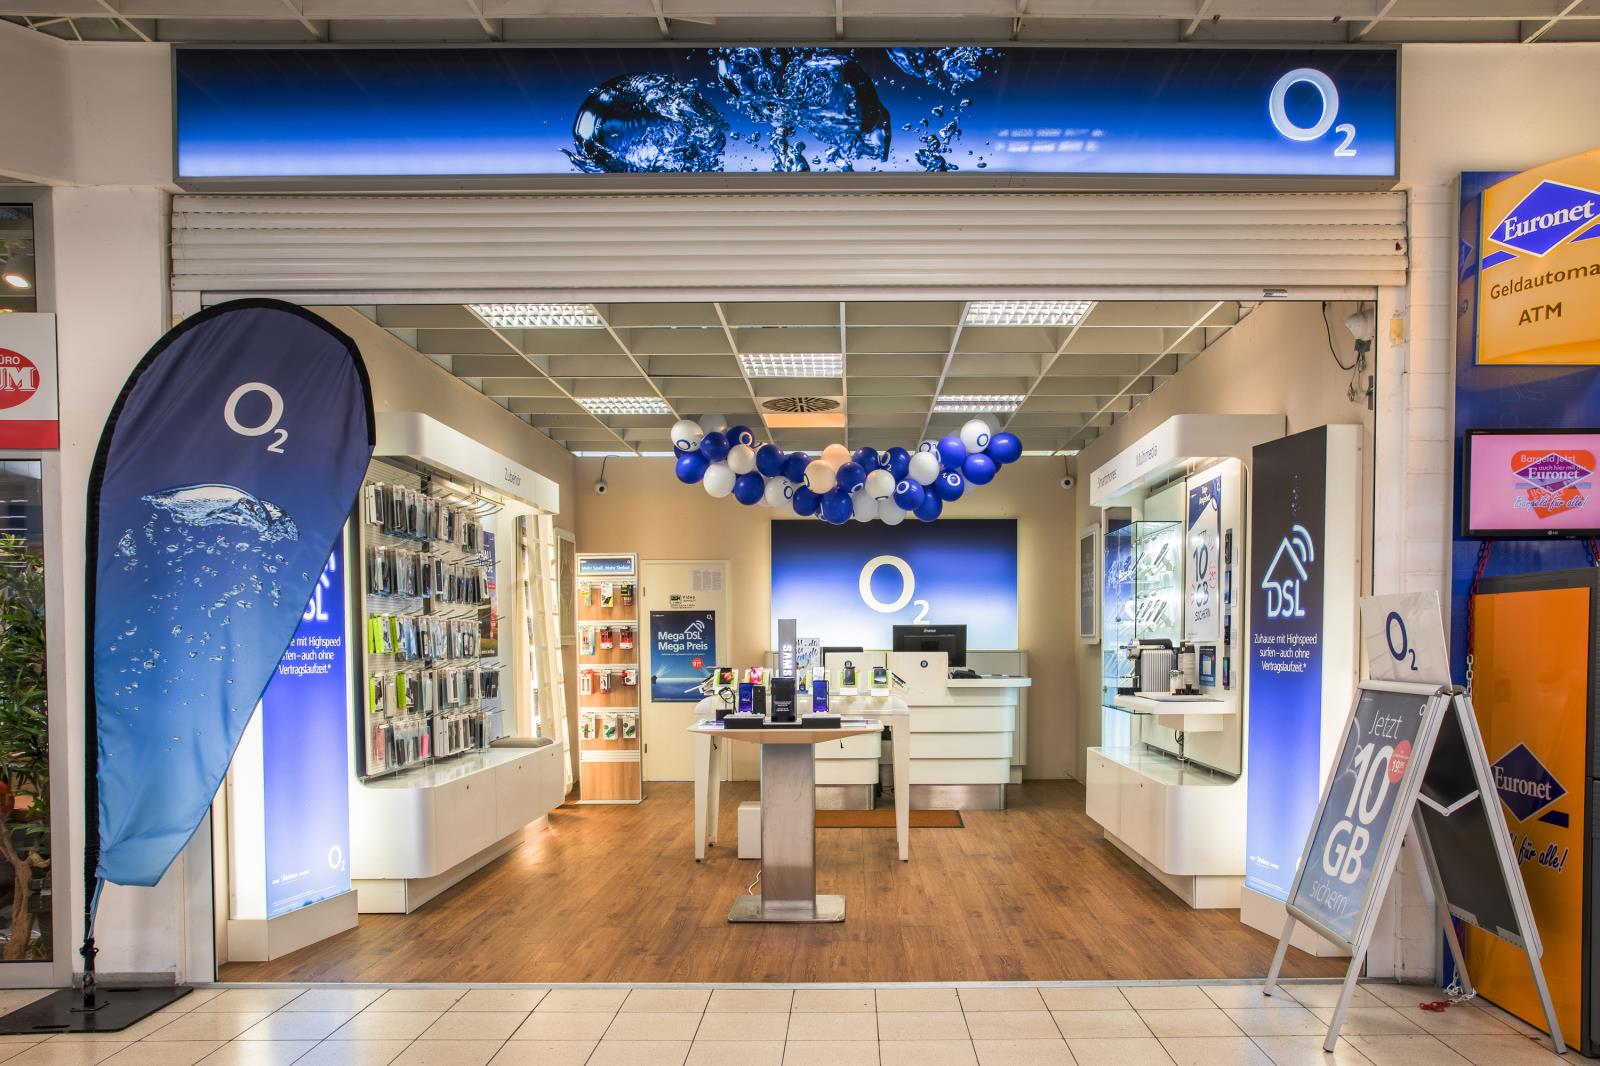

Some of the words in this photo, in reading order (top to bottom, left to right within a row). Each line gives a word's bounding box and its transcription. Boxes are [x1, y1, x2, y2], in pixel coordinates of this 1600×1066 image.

[1268, 67, 1358, 157] O2
[1502, 199, 1595, 243] Euronet
[1518, 301, 1563, 326] ATM
[224, 382, 289, 454] O2
[1528, 467, 1580, 480] Euronet
[859, 554, 930, 627] O2
[1267, 580, 1306, 617] DSL
[296, 636, 308, 647] mit
[308, 636, 341, 649] Highspeed
[658, 631, 685, 642] Mega
[686, 631, 702, 640] DSL
[658, 641, 685, 652] Mega
[686, 641, 708, 651] Preis
[1254, 633, 1276, 644] Zuhause
[1276, 633, 1286, 644] mit
[1286, 633, 1318, 647] Highspeed
[1385, 611, 1418, 671] O2
[318, 650, 335, 660] ohne
[1294, 648, 1310, 659] ohne
[1367, 709, 1404, 740] Jetzt
[1343, 742, 1395, 825] 10
[1494, 764, 1552, 801] Euronet
[327, 845, 346, 872] O2
[1323, 820, 1370, 884] GB
[1538, 843, 1569, 873] alle!
